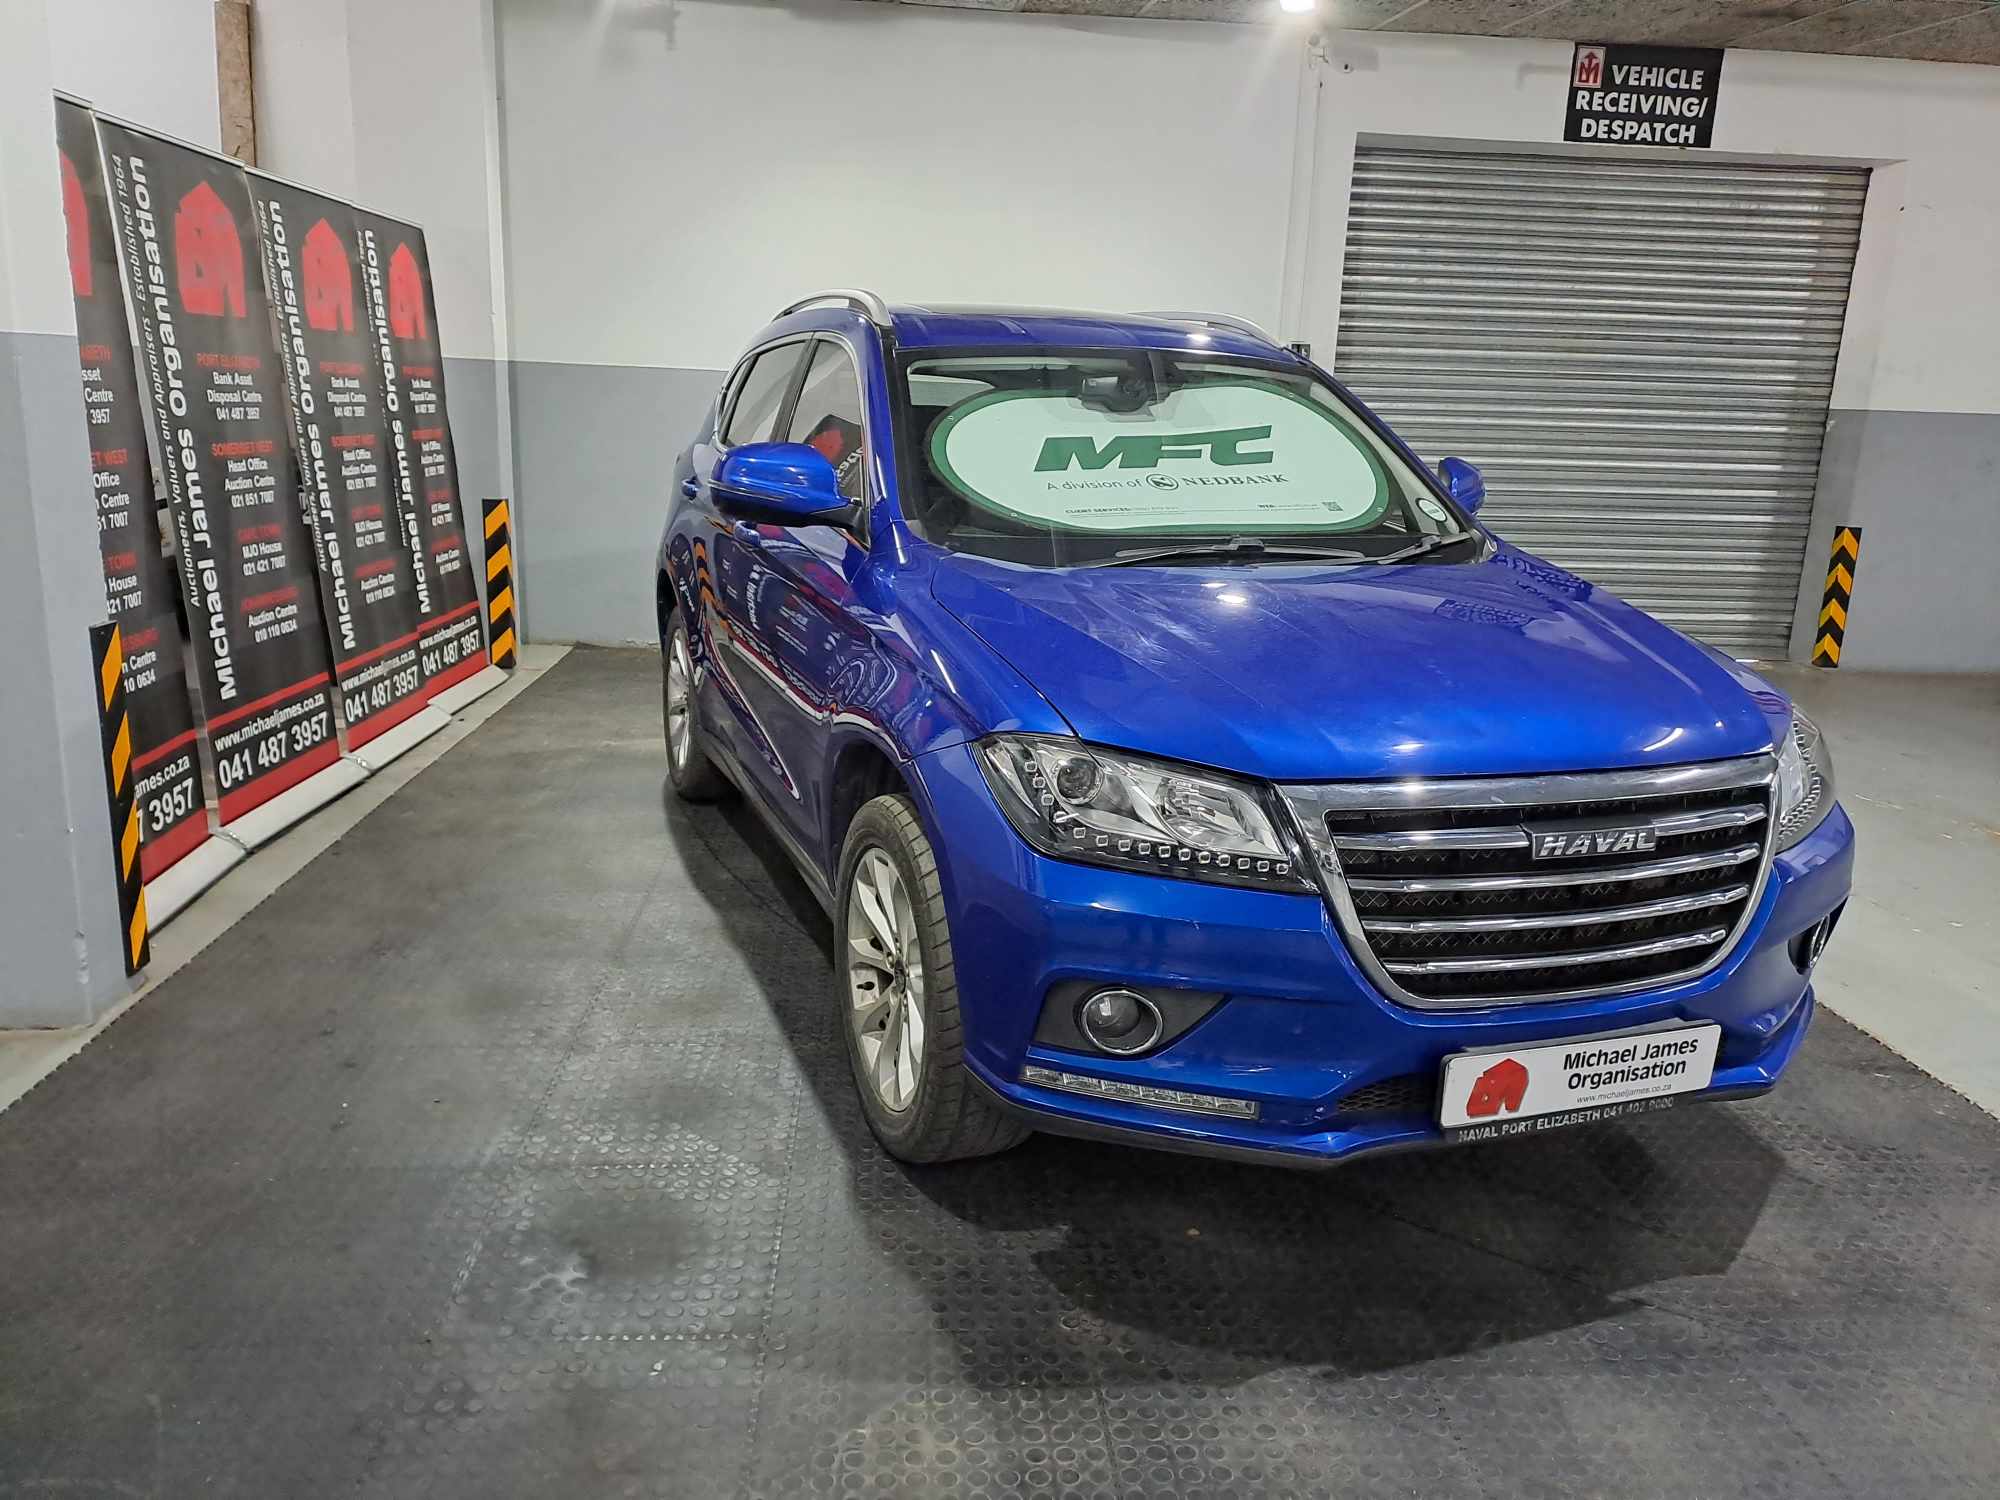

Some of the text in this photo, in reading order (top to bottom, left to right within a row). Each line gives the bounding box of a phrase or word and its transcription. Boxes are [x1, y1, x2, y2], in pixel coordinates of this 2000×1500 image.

[1612, 64, 1705, 90] VEHICLE
[1575, 91, 1708, 119] RECEIVING/
[1580, 118, 1696, 144] DESPATCH
[111, 154, 129, 200] 1964
[122, 203, 145, 300] Established
[364, 230, 399, 412] Organisation
[82, 367, 101, 381] sset
[143, 318, 164, 406] Appraisers
[213, 371, 233, 386] Bank
[84, 387, 114, 403] Centre
[207, 389, 241, 405] Disposal
[90, 408, 110, 424] 3957
[158, 411, 172, 439] and
[216, 407, 230, 421] 041
[269, 200, 356, 650] Michael James Organisation
[130, 156, 238, 701] Michael James Organisation
[1034, 424, 1274, 472] MFC
[164, 445, 182, 504] Valuers
[227, 457, 268, 473] Head Office
[392, 420, 414, 506] James
[93, 471, 120, 488] Office
[225, 477, 253, 491] Auction
[1047, 473, 1289, 490] A division of NEDBANK
[101, 492, 130, 509] Centre
[231, 493, 245, 508] 021
[245, 492, 259, 506] 851
[108, 511, 128, 529] 7007
[177, 510, 201, 607] Auctioneers,
[259, 542, 283, 556] House
[405, 512, 431, 613] Michael
[243, 561, 256, 576] 021
[108, 574, 137, 592] House
[123, 591, 142, 609] 7007
[248, 610, 275, 628] Auction
[129, 651, 156, 669] Centre
[422, 629, 481, 677] 041 487 3957
[124, 669, 156, 694] 10 0634
[341, 649, 416, 692] www.michaeljames.co.za
[344, 665, 419, 722] 041 487 3957
[215, 692, 324, 752] www.michaeljames.co.za
[219, 711, 328, 789] 041 487 3957
[149, 777, 193, 831] 3957
[1539, 829, 1656, 857] HAVAL
[1563, 1038, 1699, 1070] Michael James
[1568, 1060, 1687, 1090] Organisation
[1576, 1084, 1672, 1104] www.michaeljames.co.za
[1458, 1127, 1499, 1143] HAVAL
[1502, 1121, 1534, 1136] PORT
[1536, 1110, 1601, 1130] ELIZABETH
